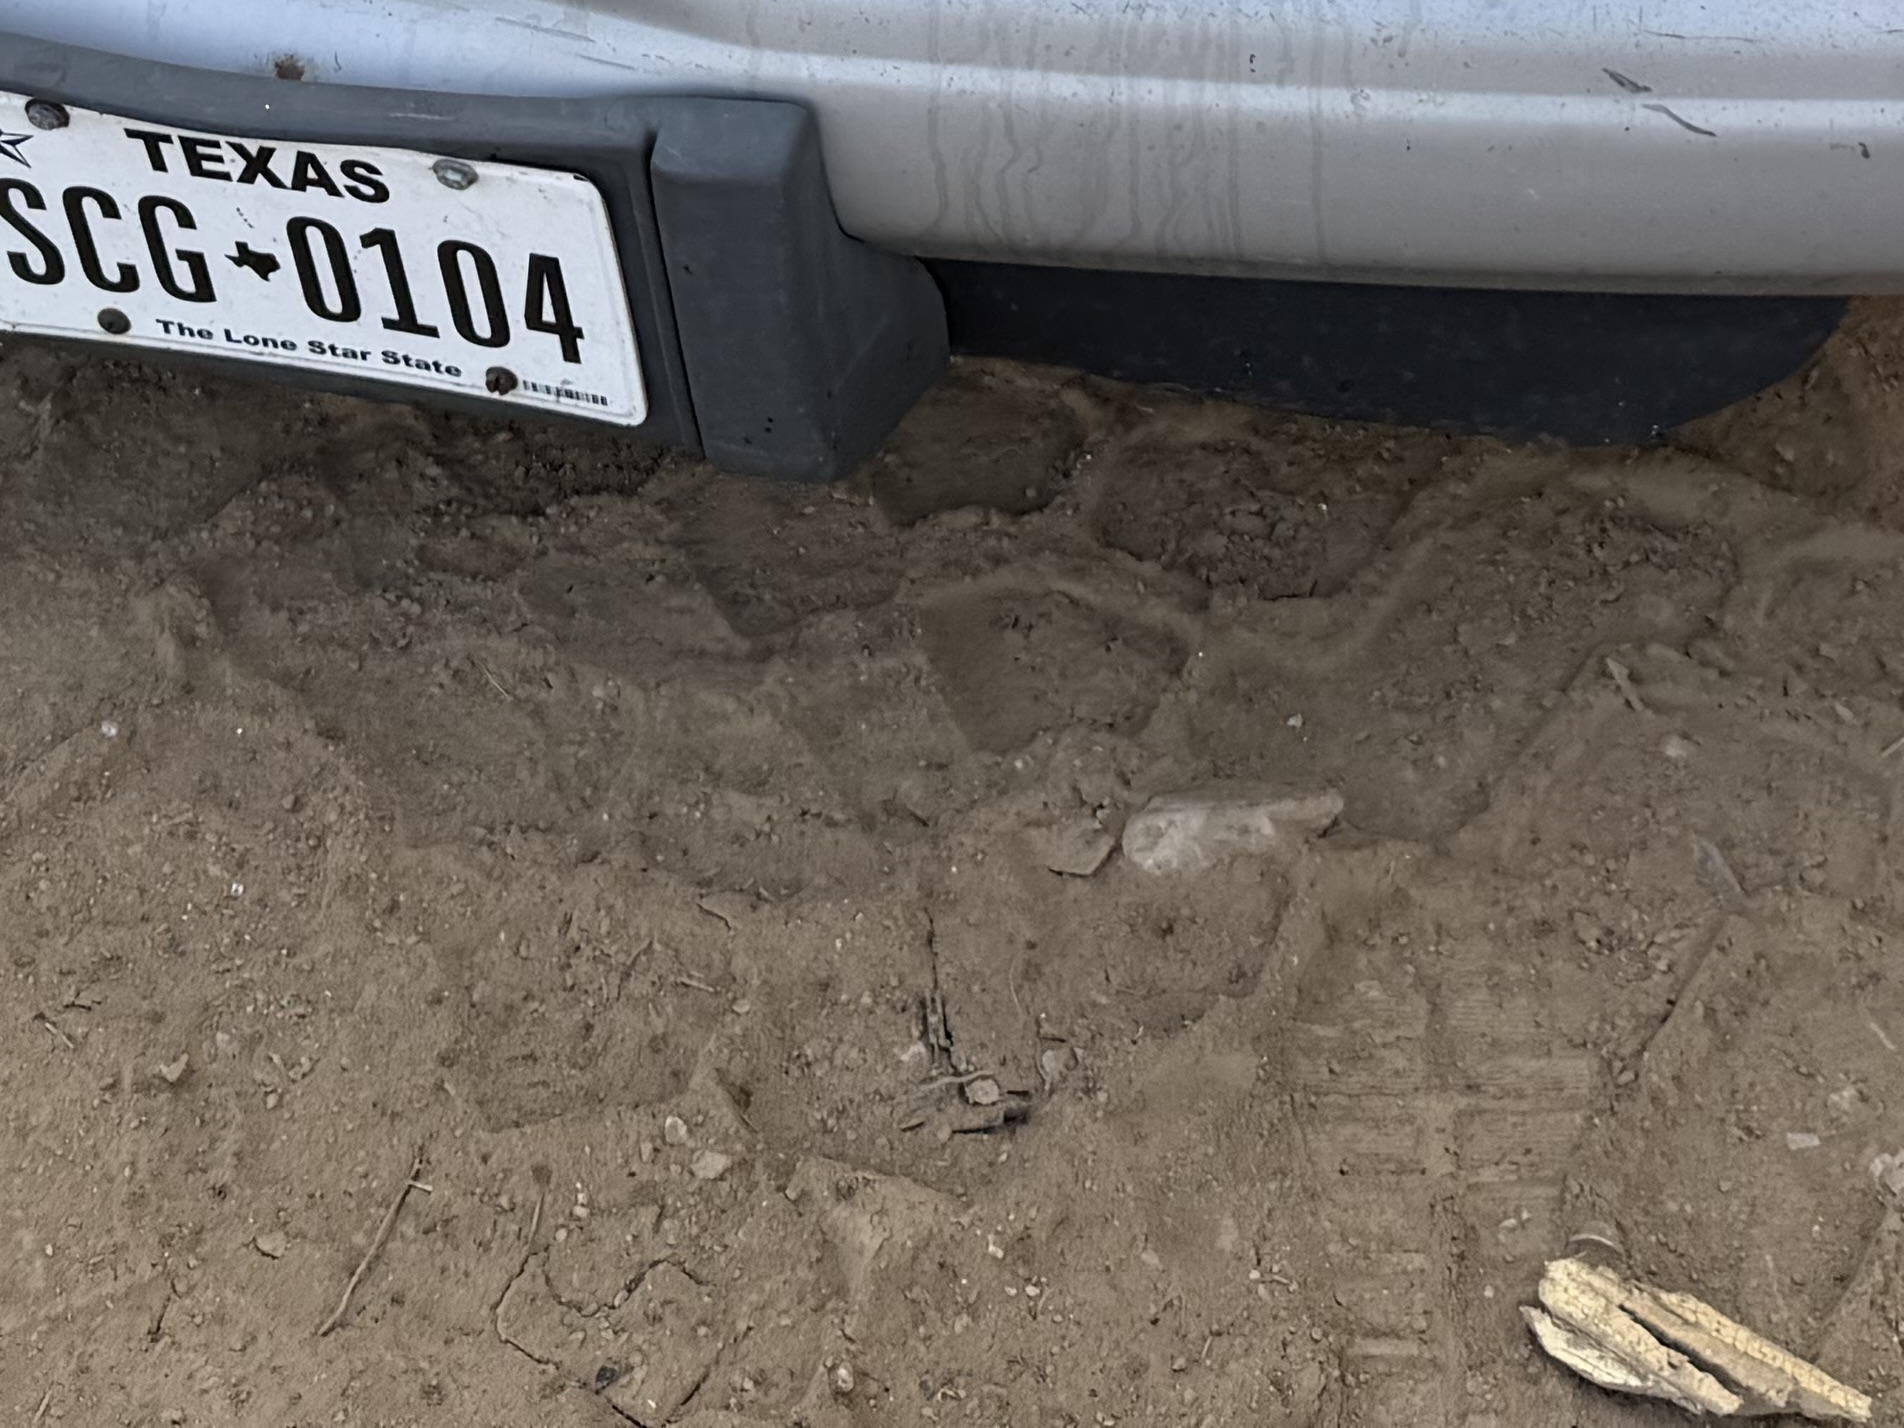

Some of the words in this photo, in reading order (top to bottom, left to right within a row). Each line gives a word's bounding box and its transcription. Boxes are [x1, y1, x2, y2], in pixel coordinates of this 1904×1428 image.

[124, 127, 390, 204] TEXAS
[155, 317, 214, 341] The
[224, 328, 298, 352] Lone
[307, 339, 371, 363] Star
[381, 349, 462, 378] State
